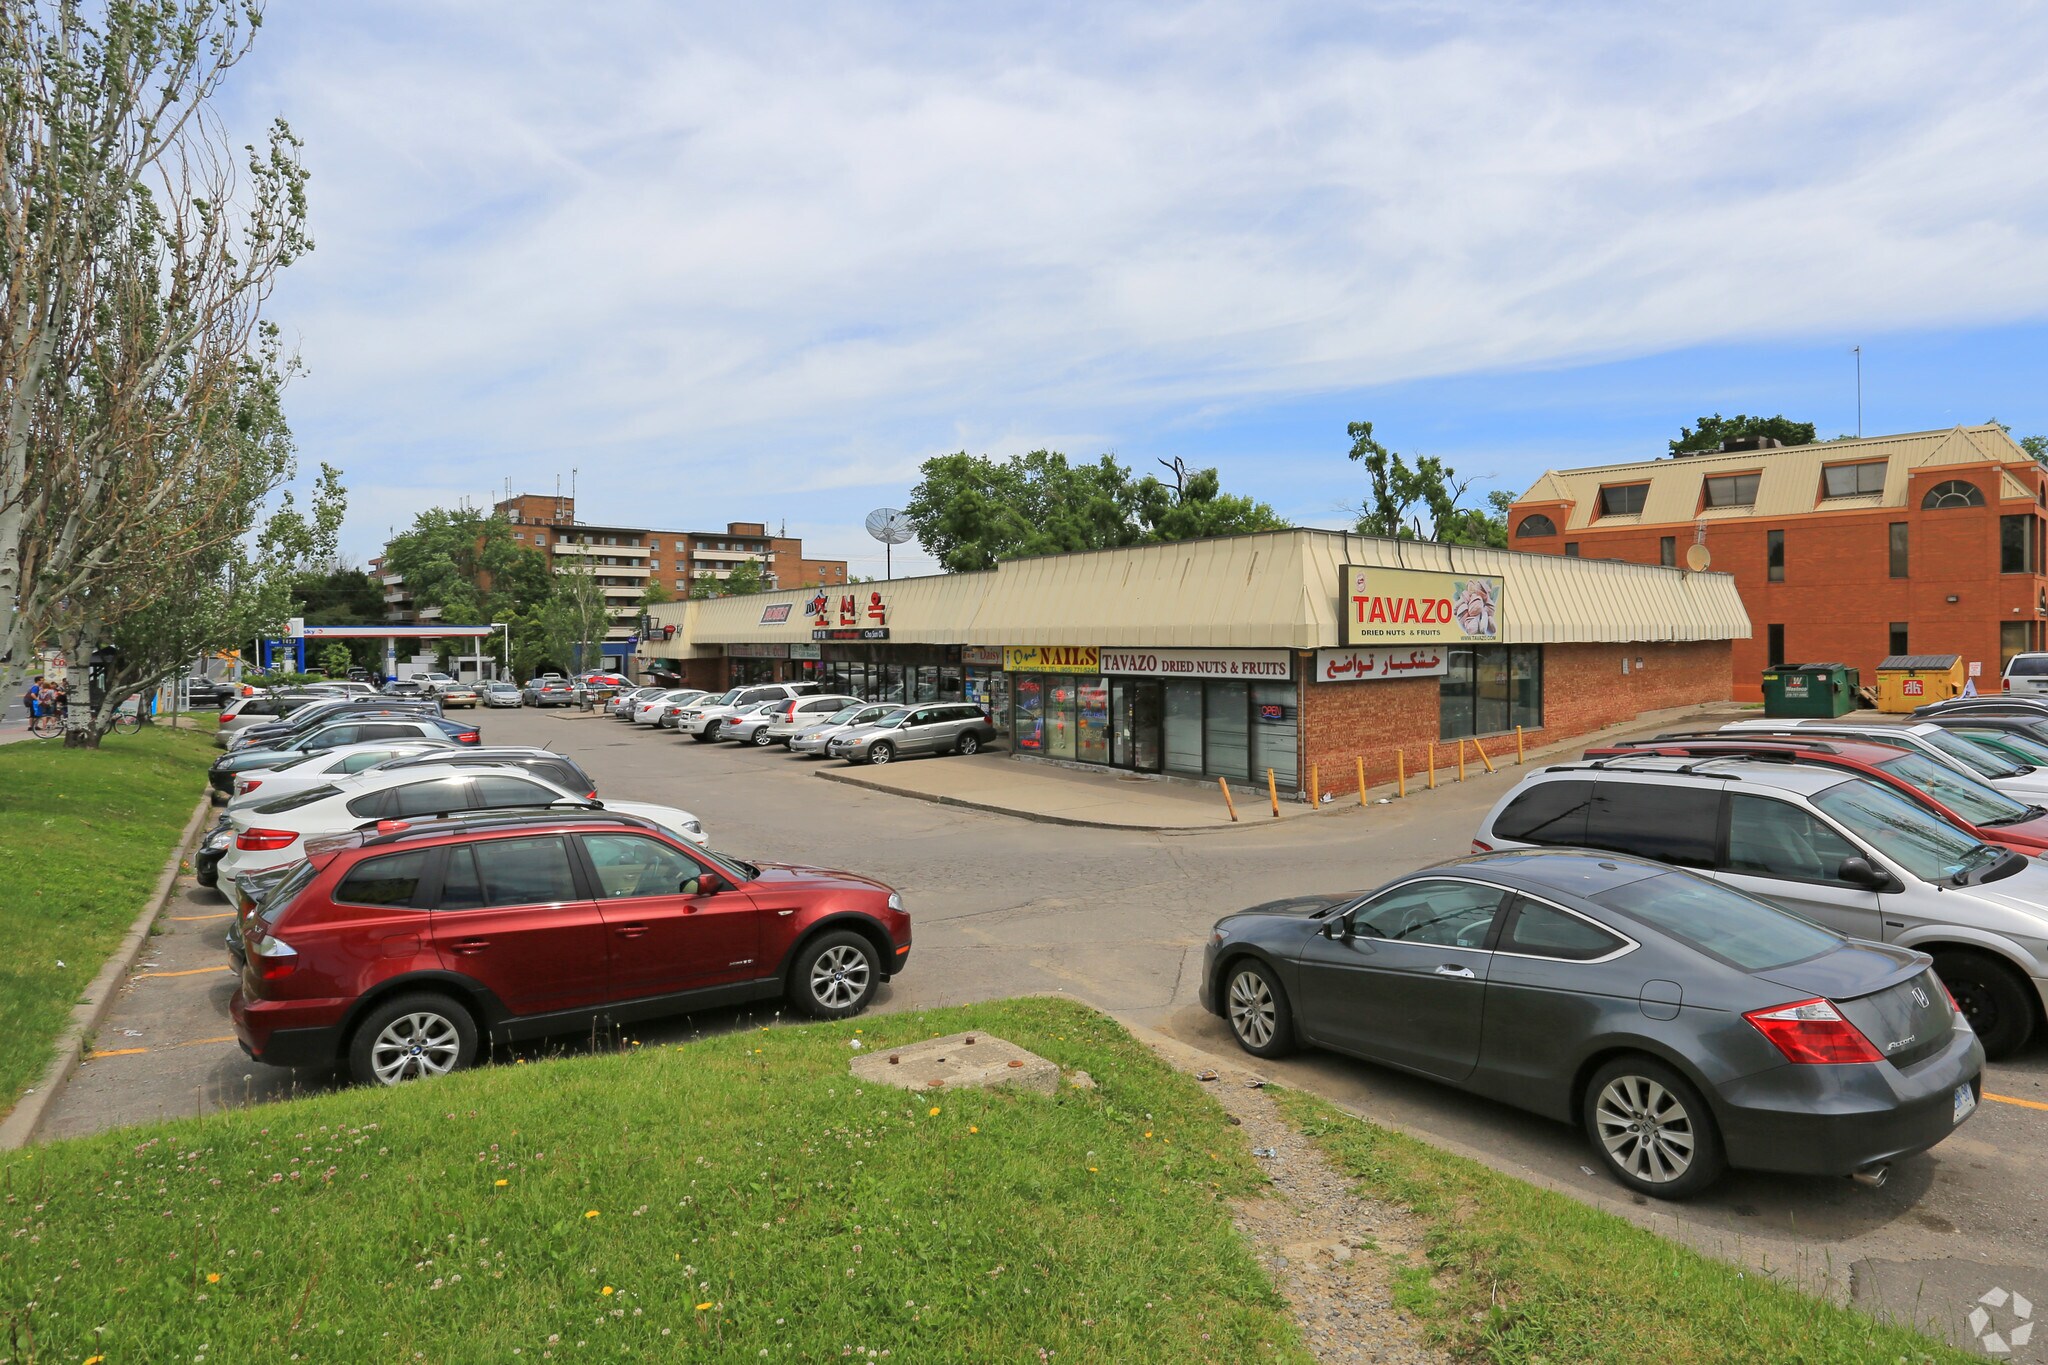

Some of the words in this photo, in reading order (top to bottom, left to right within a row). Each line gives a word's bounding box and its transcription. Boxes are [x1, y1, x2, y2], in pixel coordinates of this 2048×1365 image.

[1352, 595, 1452, 624] TAVAZO
[980, 648, 999, 663] Daisy
[1040, 647, 1097, 665] NAILS
[1102, 654, 1158, 672] TAVAZO
[1161, 660, 1194, 673] DRIED
[1197, 661, 1227, 674] NUTS
[1230, 661, 1239, 674] &
[1241, 661, 1286, 675] FRUITS
[1327, 653, 1375, 679] تواضع
[1262, 705, 1281, 716] OPEN
[1887, 1034, 1915, 1050] Accord
